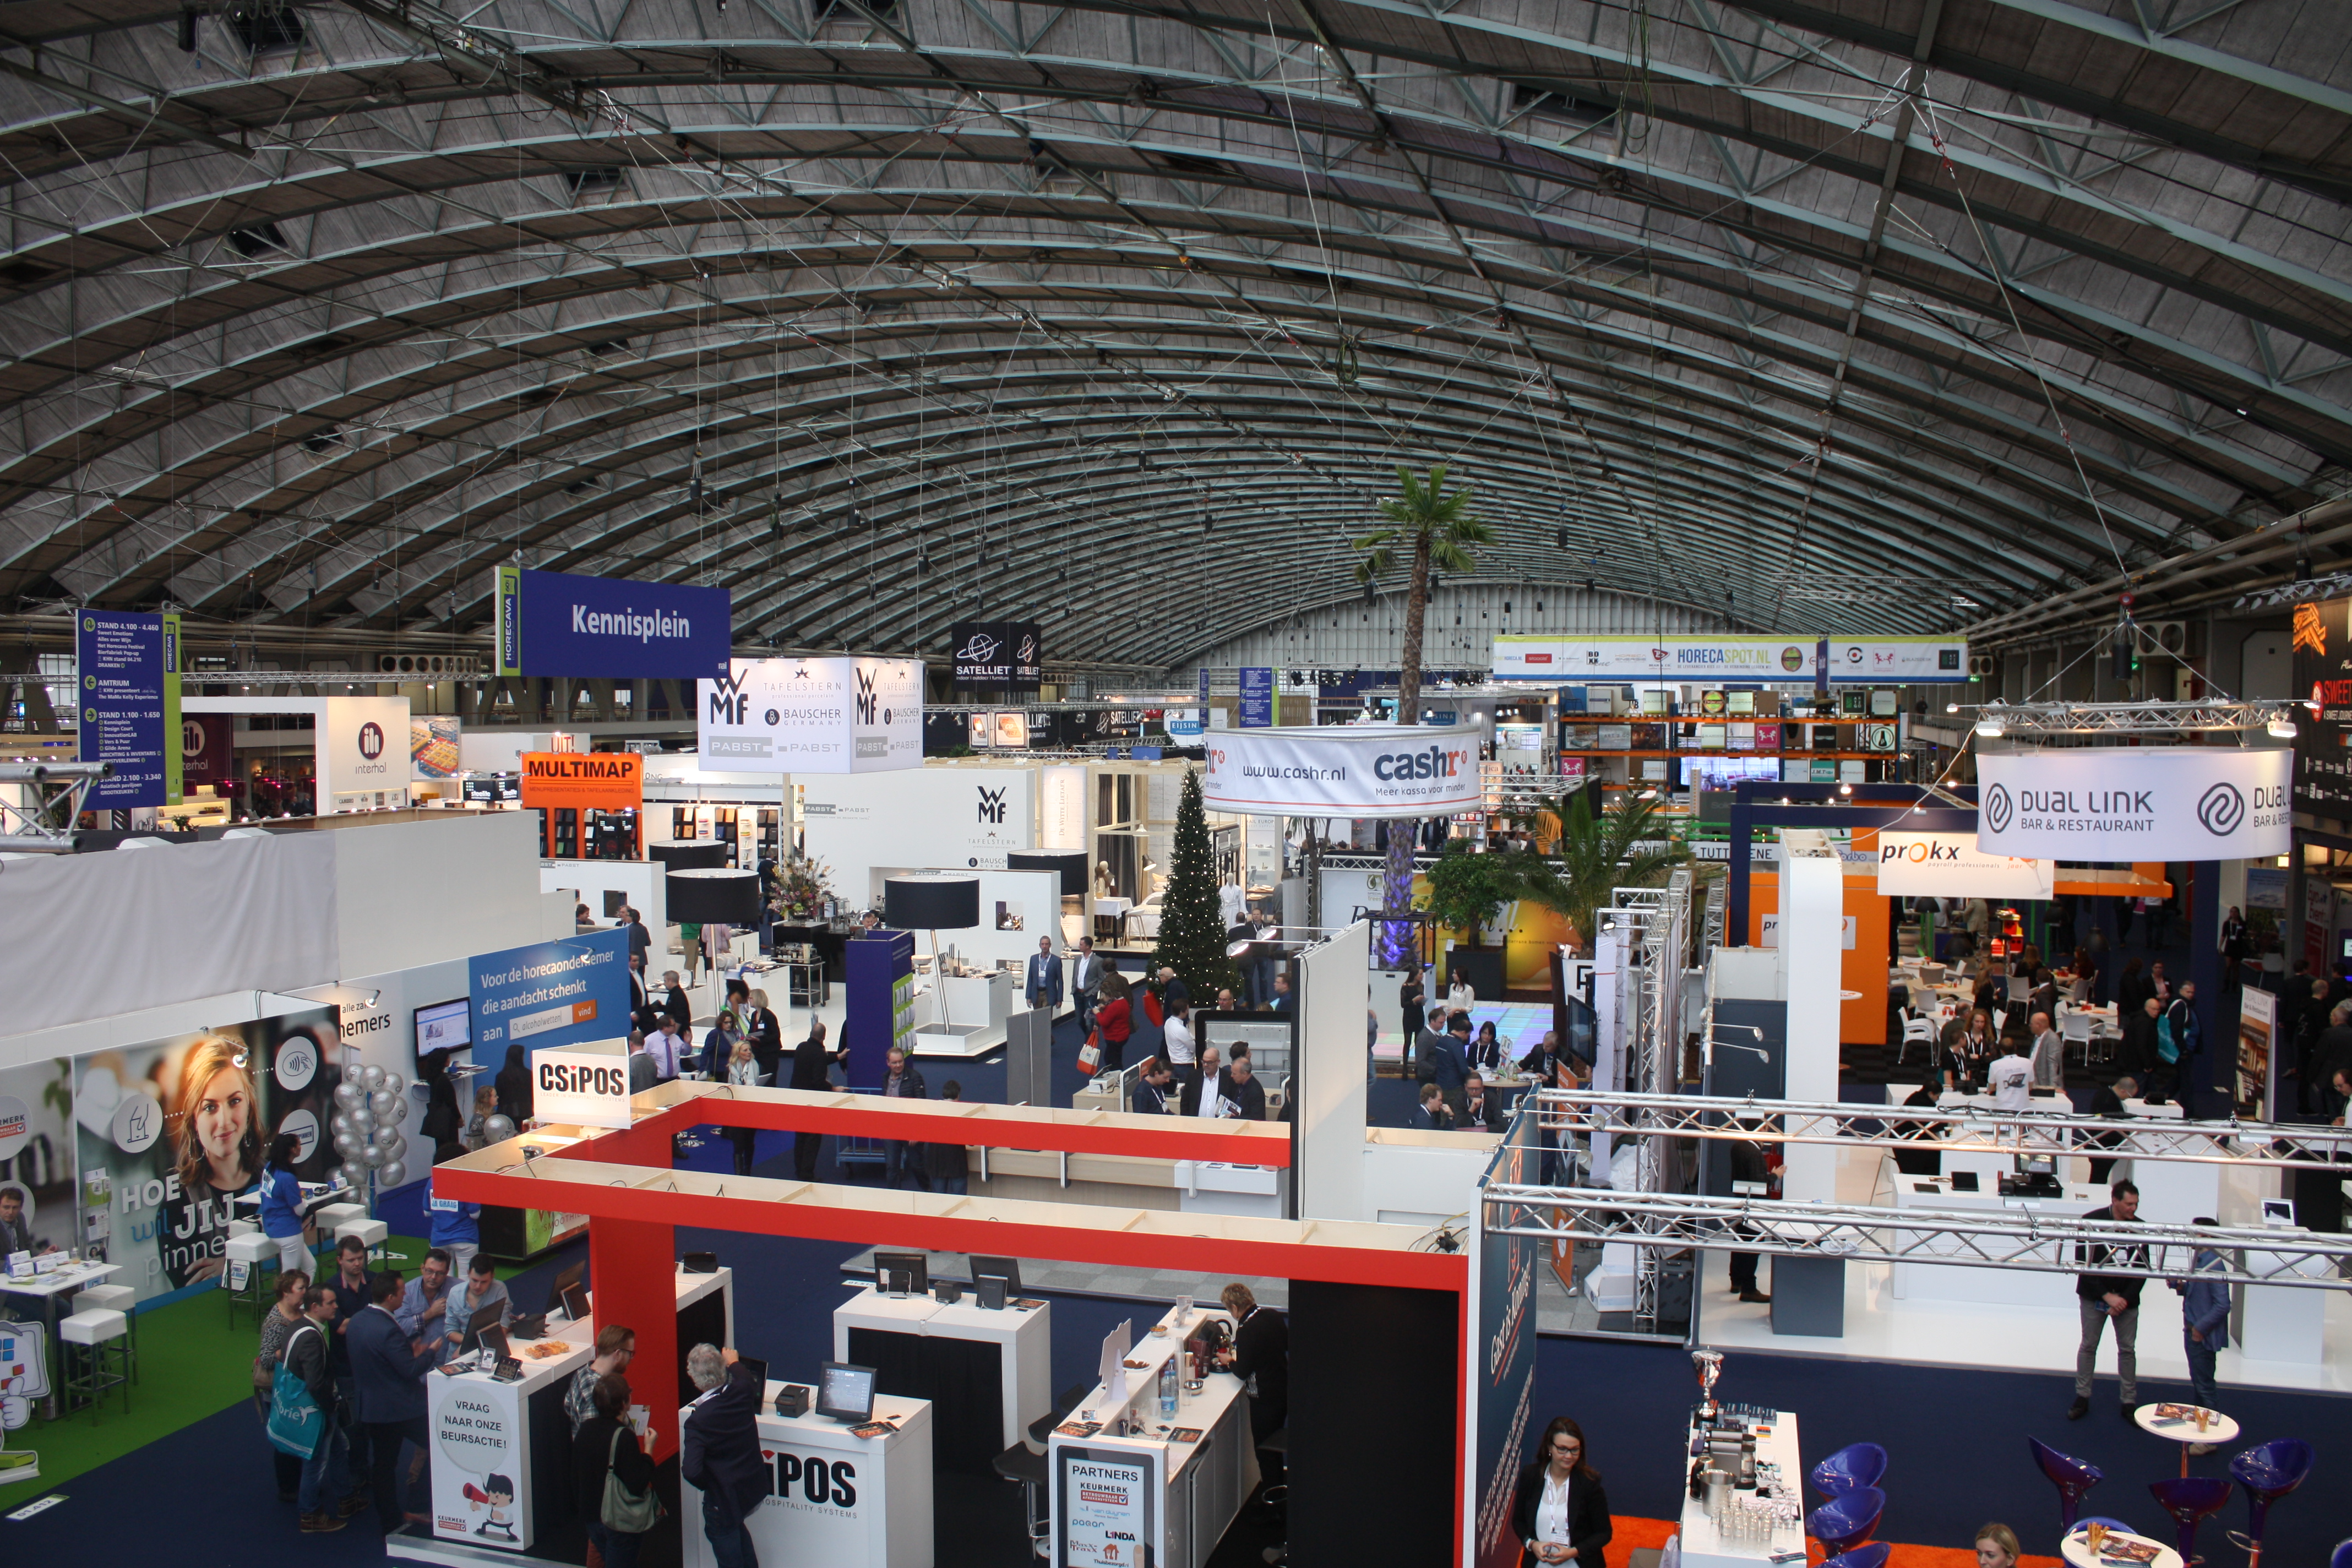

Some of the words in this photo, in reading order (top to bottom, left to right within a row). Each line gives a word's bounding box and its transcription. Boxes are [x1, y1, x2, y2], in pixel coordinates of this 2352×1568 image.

[572, 604, 690, 643] Kennisplein
[1678, 649, 1771, 664] HORECASPOT.NL
[718, 662, 727, 670] rai
[956, 666, 1010, 675] SATELLIET
[1017, 666, 1039, 675] SATELLIET
[764, 682, 842, 691] TAFELSTERN
[784, 709, 841, 718] BAUSCHER
[893, 707, 920, 717] BAUSCHER
[551, 735, 575, 753] UIT!
[712, 742, 761, 752] PABST
[790, 744, 841, 752] PABST
[857, 743, 883, 752] PABST
[895, 741, 919, 750] PABST
[183, 759, 208, 770] terhal
[355, 762, 386, 775] interhal
[529, 761, 633, 777] MULTIMAP
[1374, 745, 1460, 781] cashr
[1243, 765, 1346, 781] www.cashr.nl
[1375, 787, 1398, 796] Meer
[1401, 785, 1427, 796] kassa
[1429, 785, 1444, 794] voor
[1446, 783, 1466, 792] minder
[2021, 818, 2043, 830] BAR
[2046, 819, 2055, 830] &
[2058, 819, 2154, 831] RESTAURANT
[2254, 815, 2271, 827] BAR
[1881, 841, 1961, 863] prokx
[481, 973, 507, 988] Voor
[509, 967, 521, 983] de
[482, 999, 499, 1015] die
[500, 988, 548, 1011] aandacht
[549, 979, 587, 1000] schenkt
[342, 1003, 355, 1014] alle
[483, 1026, 503, 1041] aan
[522, 1014, 561, 1031] alcoholwetten
[578, 1006, 591, 1017] vind
[122, 1173, 181, 1214] HOE
[175, 1192, 235, 1239] JIJ
[131, 1208, 171, 1243] wil
[544, 1213, 585, 1232] SMOOTHIE
[144, 1235, 226, 1287] pinne
[455, 1400, 490, 1414] VRAAG
[444, 1415, 473, 1428] NAAR
[476, 1418, 502, 1432] ONZE
[441, 1430, 507, 1450] BEURSACTIE!
[761, 1450, 857, 1509] iPOS
[1072, 1465, 1138, 1482] PARTNERS
[1080, 1482, 1128, 1494] KEURMERK
[1082, 1491, 1118, 1500] BETROUWBAAR
[438, 1515, 466, 1523] KEURMERK
[818, 1506, 858, 1519] SYSTEMS
